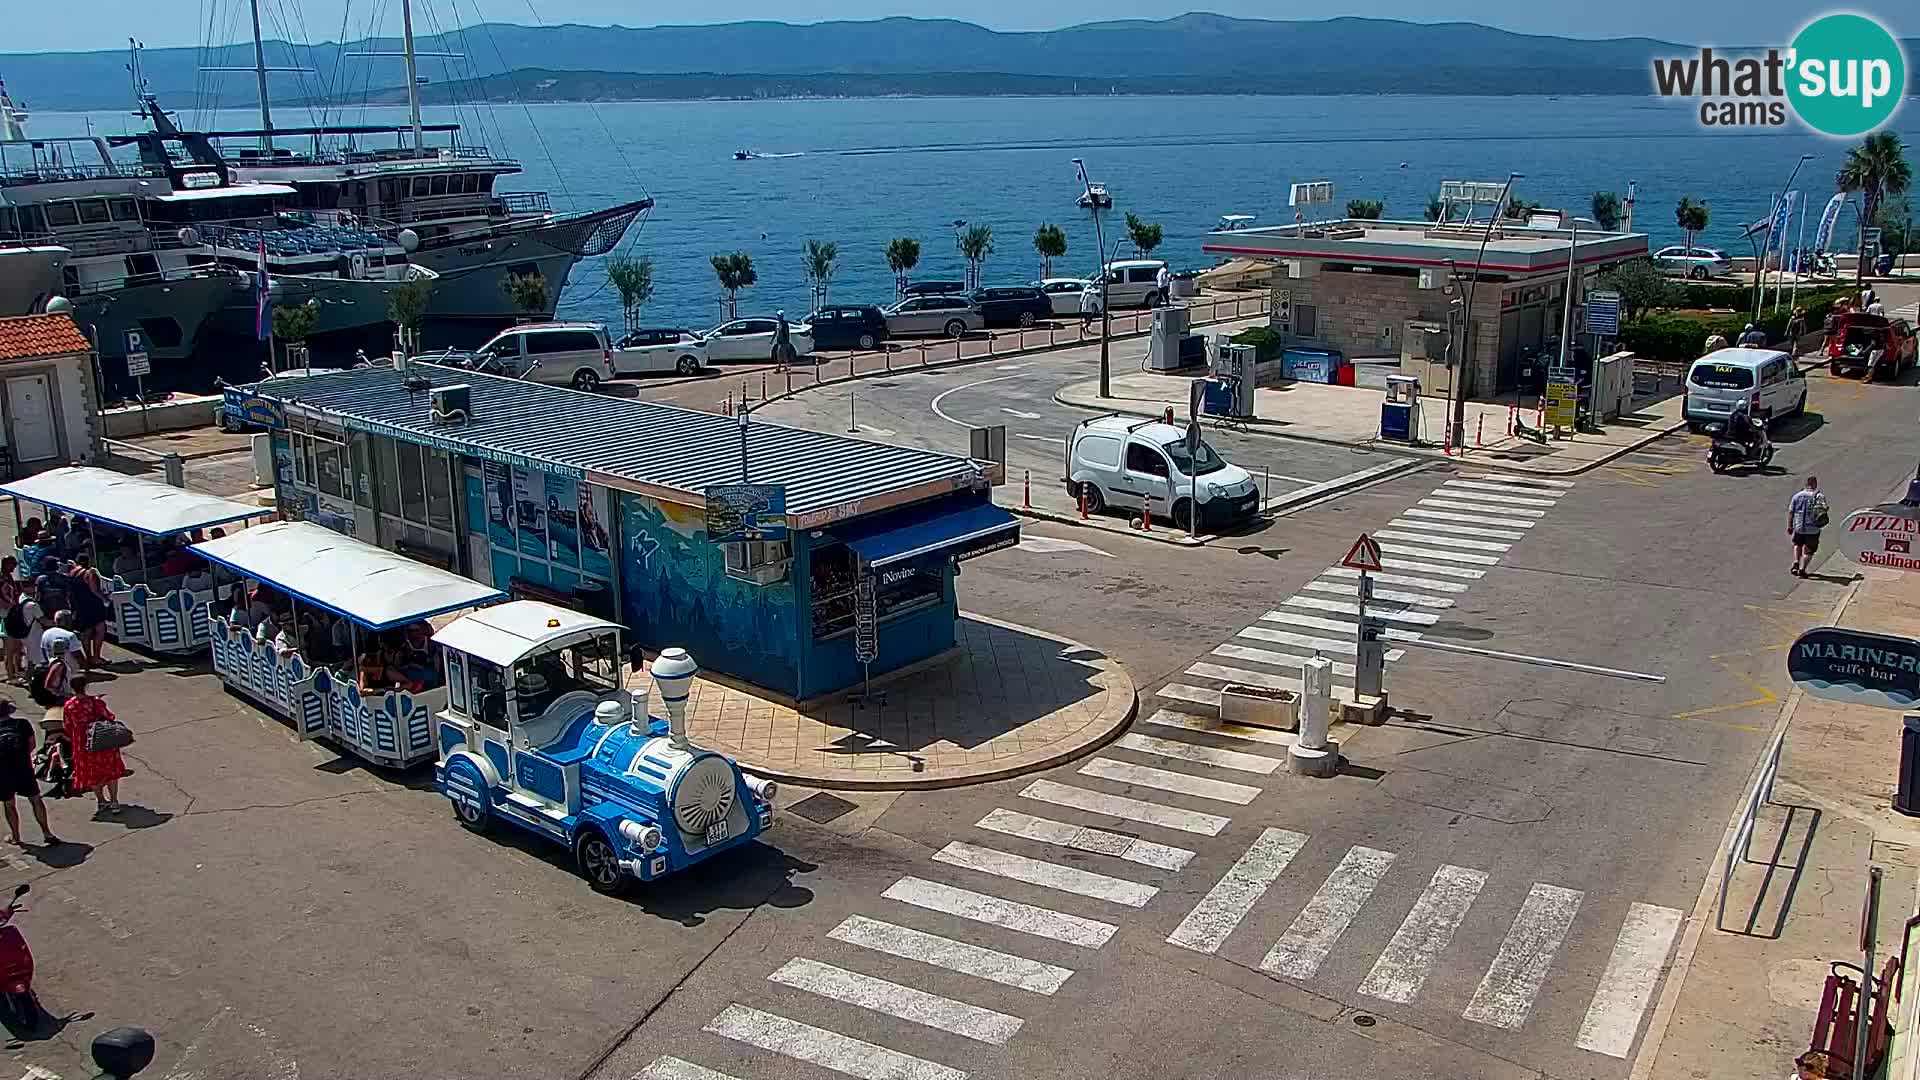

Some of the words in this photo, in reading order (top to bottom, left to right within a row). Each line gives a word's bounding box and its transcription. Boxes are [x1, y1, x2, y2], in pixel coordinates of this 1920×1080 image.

[128, 332, 141, 351] P
[1714, 365, 1733, 374] TAXI
[493, 452, 526, 467] STATION
[528, 460, 553, 474] TICKET
[554, 466, 581, 479] OFFICE
[1849, 516, 1920, 534] PIZZE
[1870, 666, 1897, 681] bar
